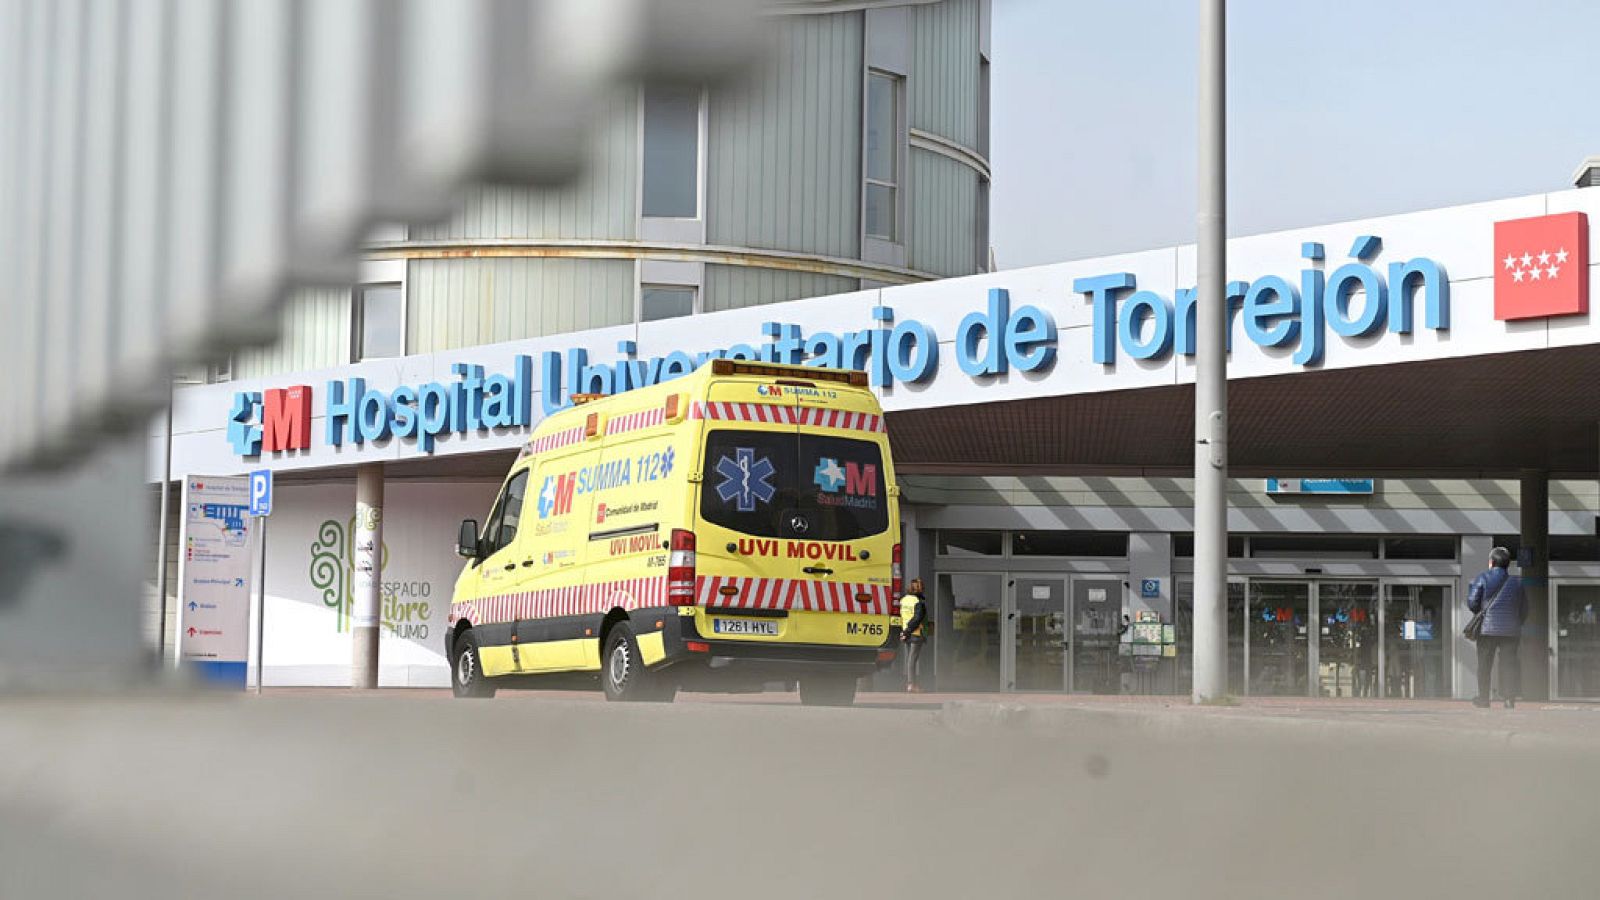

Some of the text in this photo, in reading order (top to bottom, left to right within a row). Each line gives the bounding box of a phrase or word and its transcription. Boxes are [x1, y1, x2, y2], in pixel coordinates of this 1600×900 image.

[263, 235, 1450, 453] M Hospital Univeitario de Torejón
[552, 452, 660, 516] M SUMMA 112
[846, 461, 876, 496] M
[253, 474, 267, 511] P
[610, 534, 661, 556] UVI MOVIL
[738, 538, 857, 562] UVI MOVIL
[380, 594, 432, 622] ibre
[390, 624, 429, 640] HUMO
[722, 620, 774, 634] 1261 HYL
[847, 622, 883, 636] M-765
